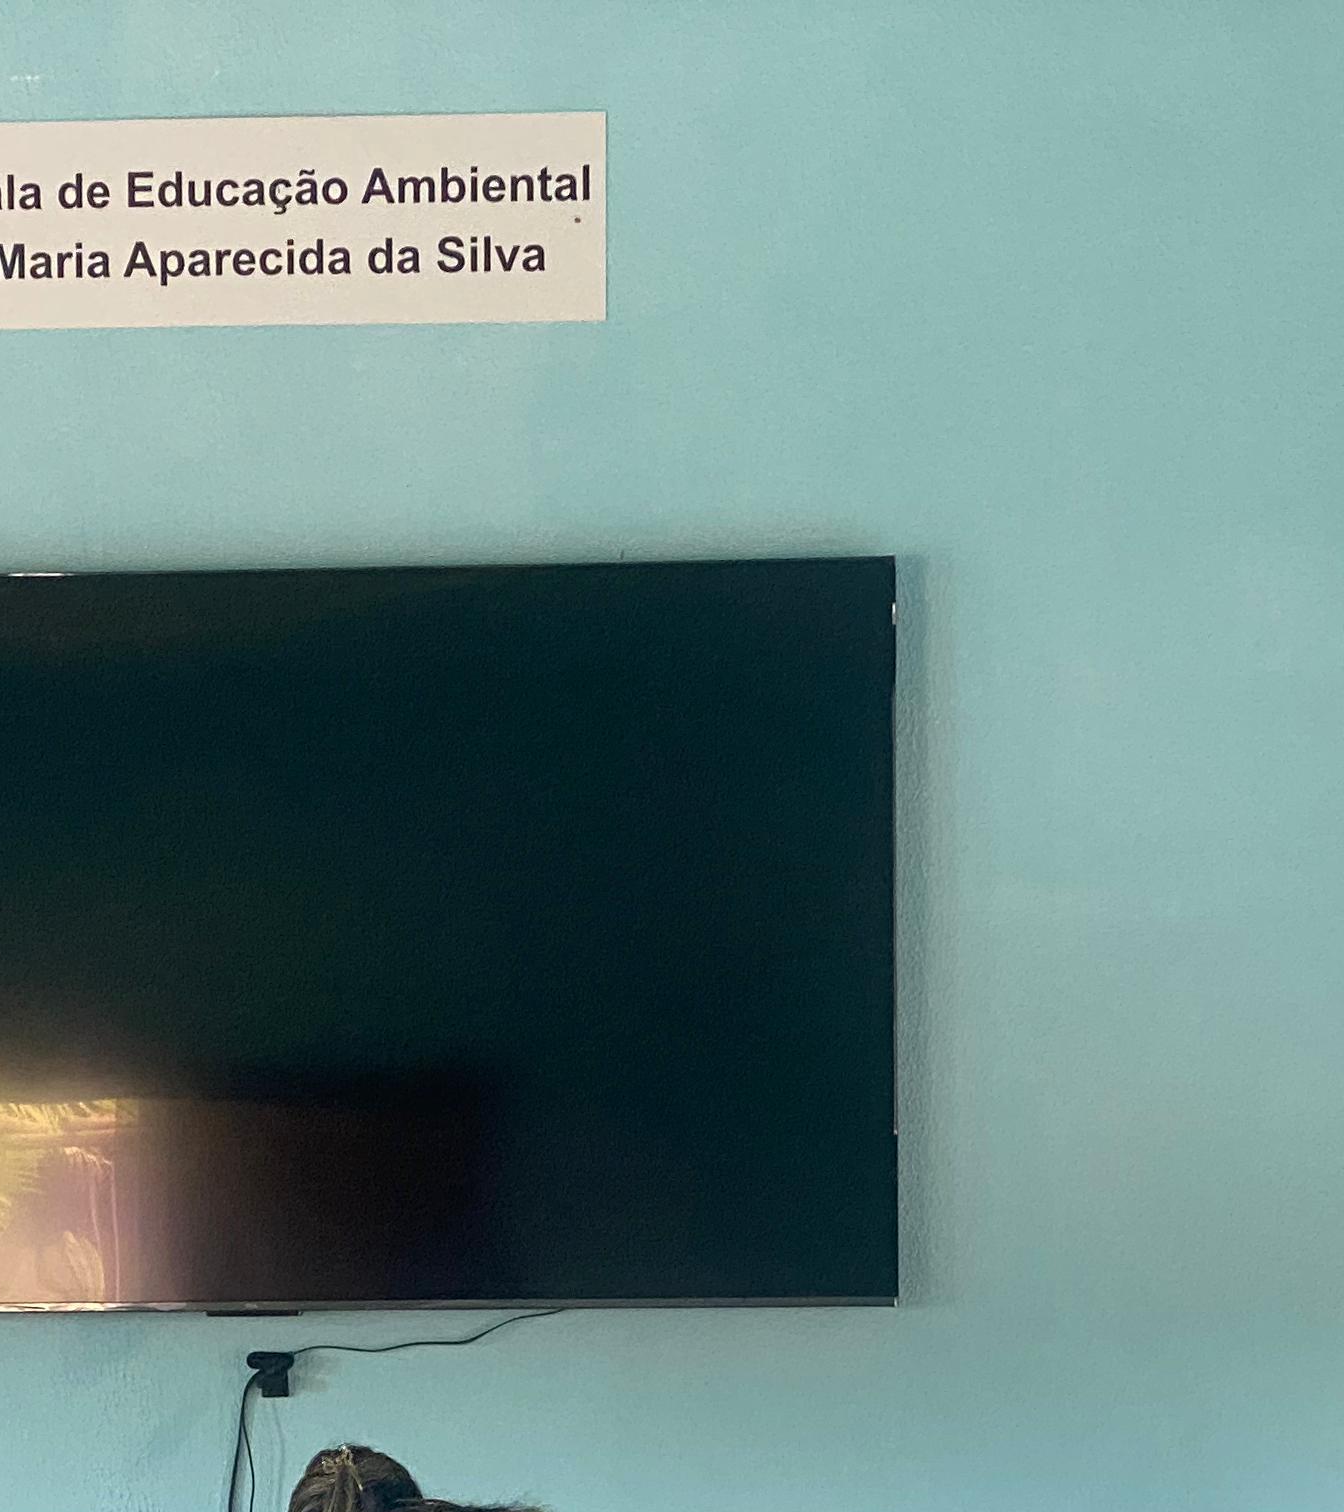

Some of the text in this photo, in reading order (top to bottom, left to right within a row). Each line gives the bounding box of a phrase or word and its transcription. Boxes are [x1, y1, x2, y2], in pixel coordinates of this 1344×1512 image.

[58, 172, 111, 209] de
[127, 168, 349, 215] Educação
[361, 164, 591, 205] Ambiental
[123, 237, 352, 286] Aparecida
[368, 237, 422, 275] da
[436, 235, 547, 275] Silva
